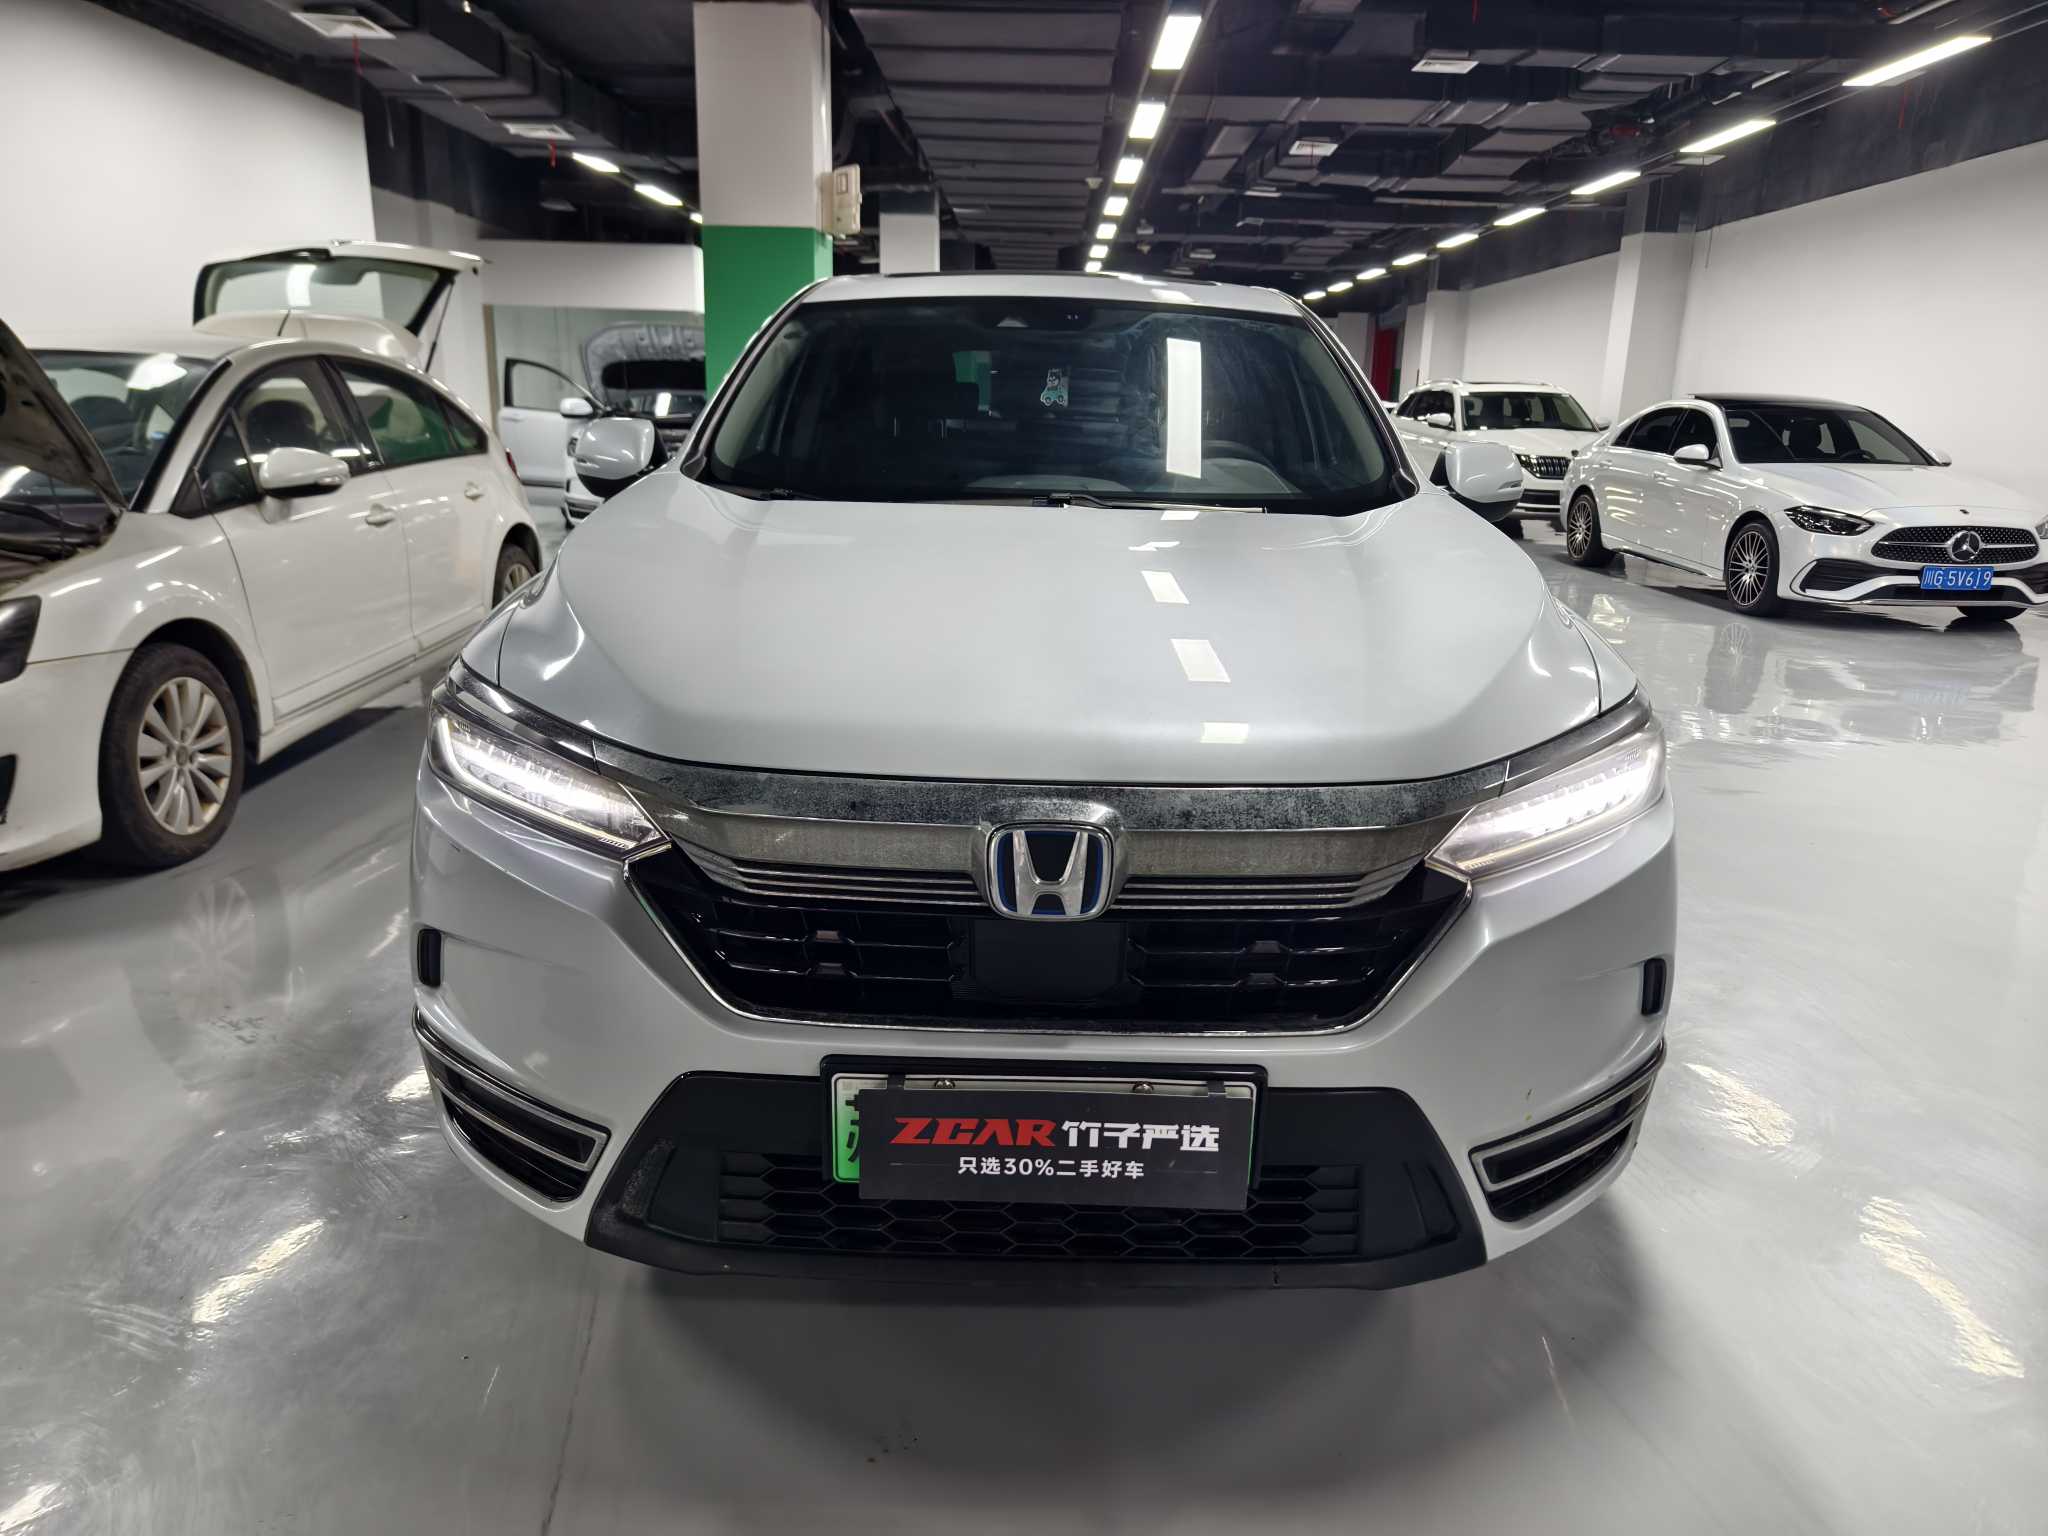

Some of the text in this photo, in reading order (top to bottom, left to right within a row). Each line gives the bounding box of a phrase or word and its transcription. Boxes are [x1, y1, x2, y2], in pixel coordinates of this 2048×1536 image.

[889, 1117, 1057, 1147] ZCAR
[1061, 1120, 1220, 1152] 竹子严选
[957, 1156, 1145, 1180] 只选30%二手好车
